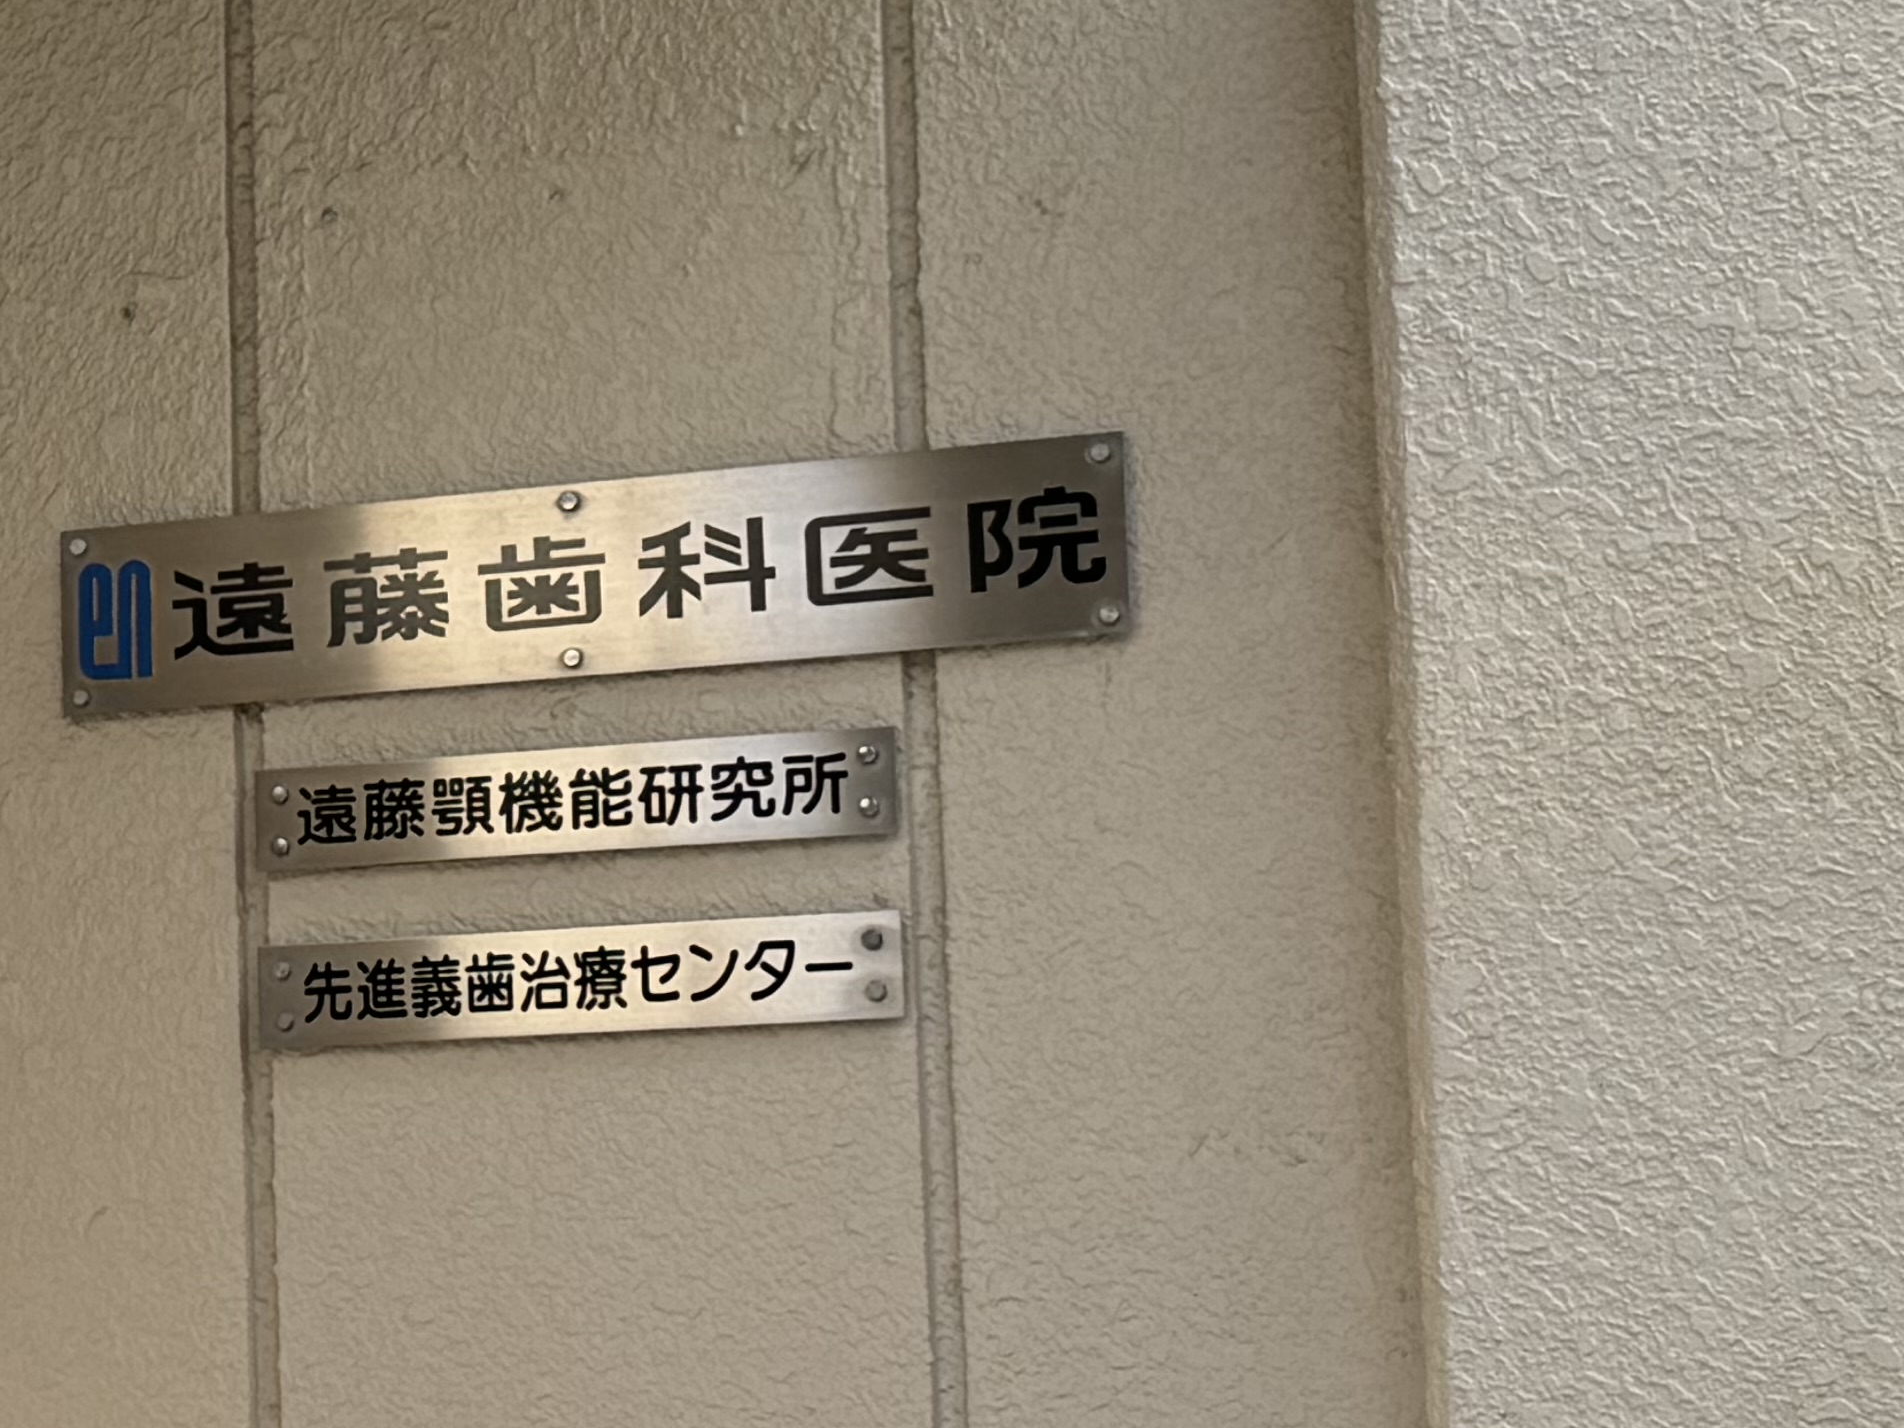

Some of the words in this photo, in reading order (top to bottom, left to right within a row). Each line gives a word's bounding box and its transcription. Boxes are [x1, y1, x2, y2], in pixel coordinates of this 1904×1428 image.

[170, 484, 1108, 660] 遠藤歯科医院
[295, 751, 850, 847] 遠藤顎機能研究所
[302, 938, 856, 1026] 先進義歯治療センター
